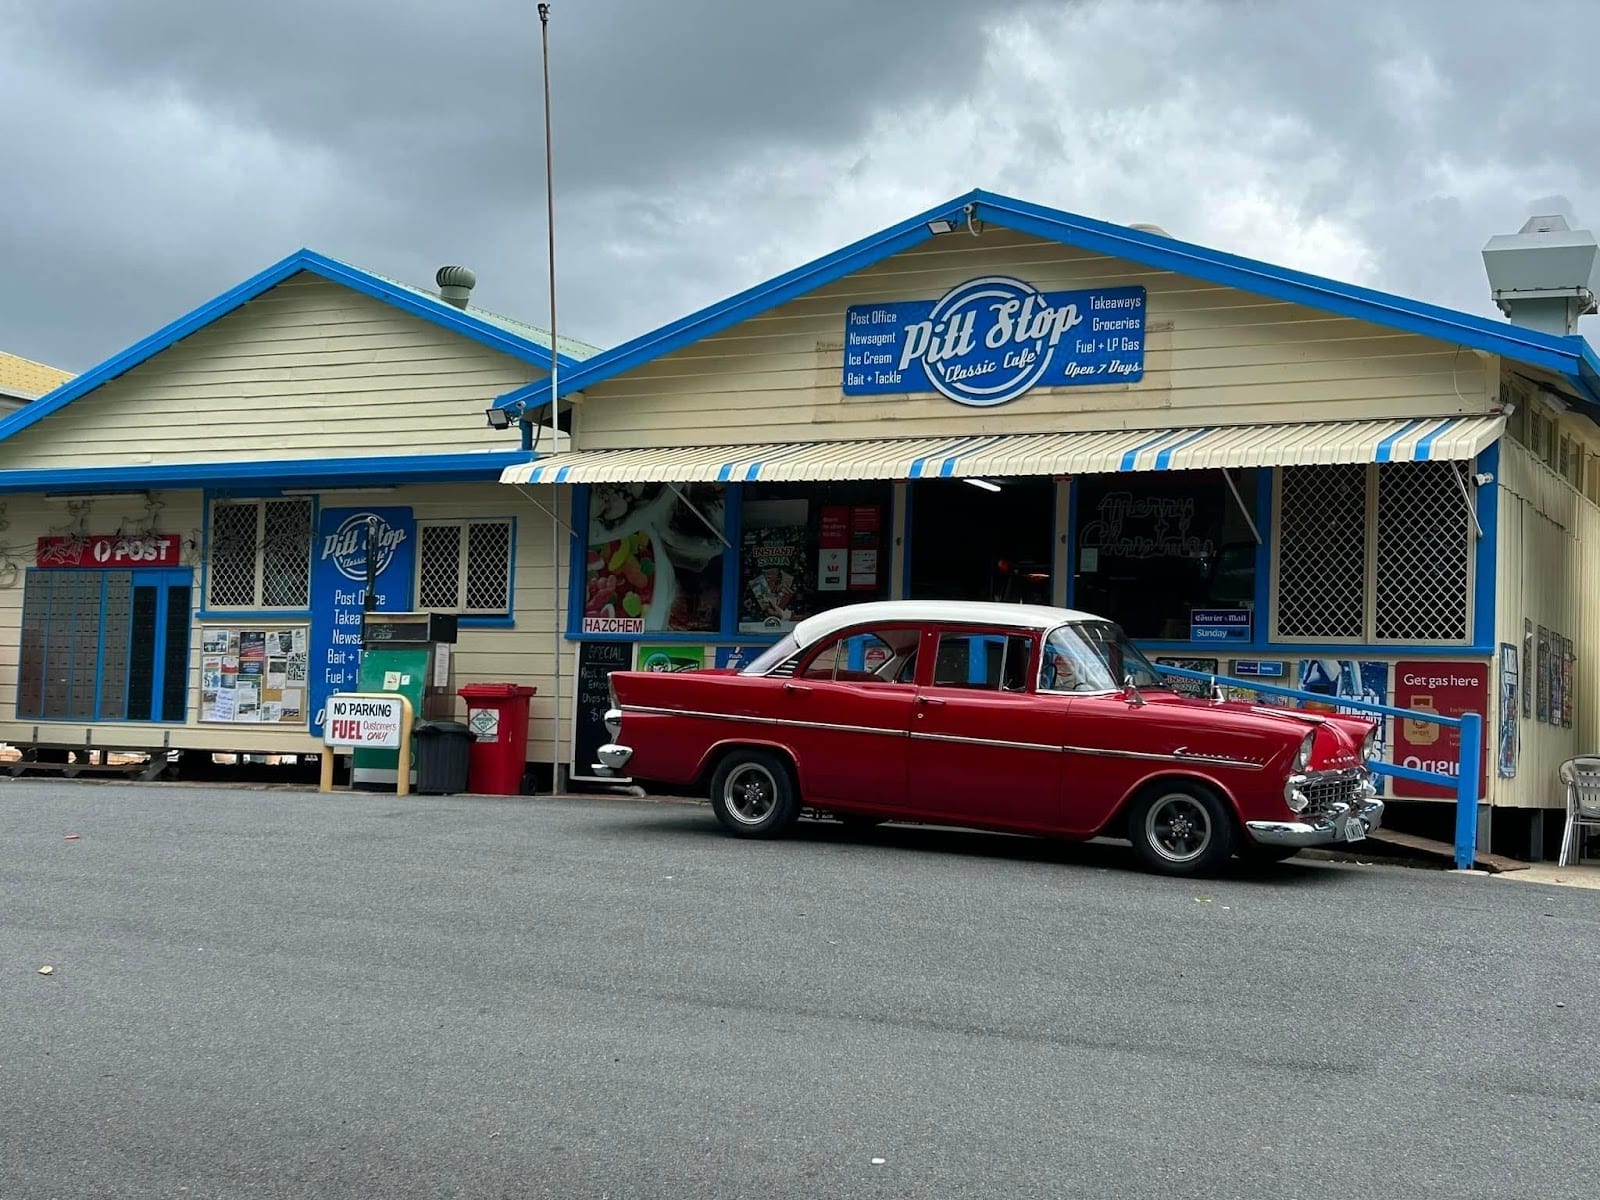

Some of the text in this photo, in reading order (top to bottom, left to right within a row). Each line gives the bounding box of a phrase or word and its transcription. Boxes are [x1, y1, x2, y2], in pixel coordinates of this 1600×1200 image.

[1089, 296, 1141, 310] Takeaways
[850, 310, 897, 325] Post Office
[1092, 317, 1140, 331] Groceries
[849, 332, 896, 346] Newsagent
[898, 295, 1083, 371] Pitt Stop
[1075, 337, 1140, 353] Fuel + LP Gas
[848, 352, 892, 365] Ice Cream
[945, 347, 1037, 383] Classic Cafe
[1064, 360, 1142, 378] Open 7 Days
[847, 372, 865, 385] Bait
[874, 370, 902, 384] Tackle
[321, 522, 407, 560] Pitt top
[115, 541, 171, 561] POST
[334, 589, 356, 605] Post
[584, 619, 643, 632] HAZCHEM
[1196, 629, 1228, 639] Sunday
[327, 648, 346, 664] Bait
[347, 653, 355, 661] +
[325, 668, 345, 684] Fuel
[346, 673, 353, 681] +
[1404, 673, 1479, 689] Get gas here
[334, 703, 392, 717] NO PARKING
[331, 719, 397, 740] FUEL Customers
[366, 732, 389, 742] ONLY
[1403, 756, 1460, 776] Origi
